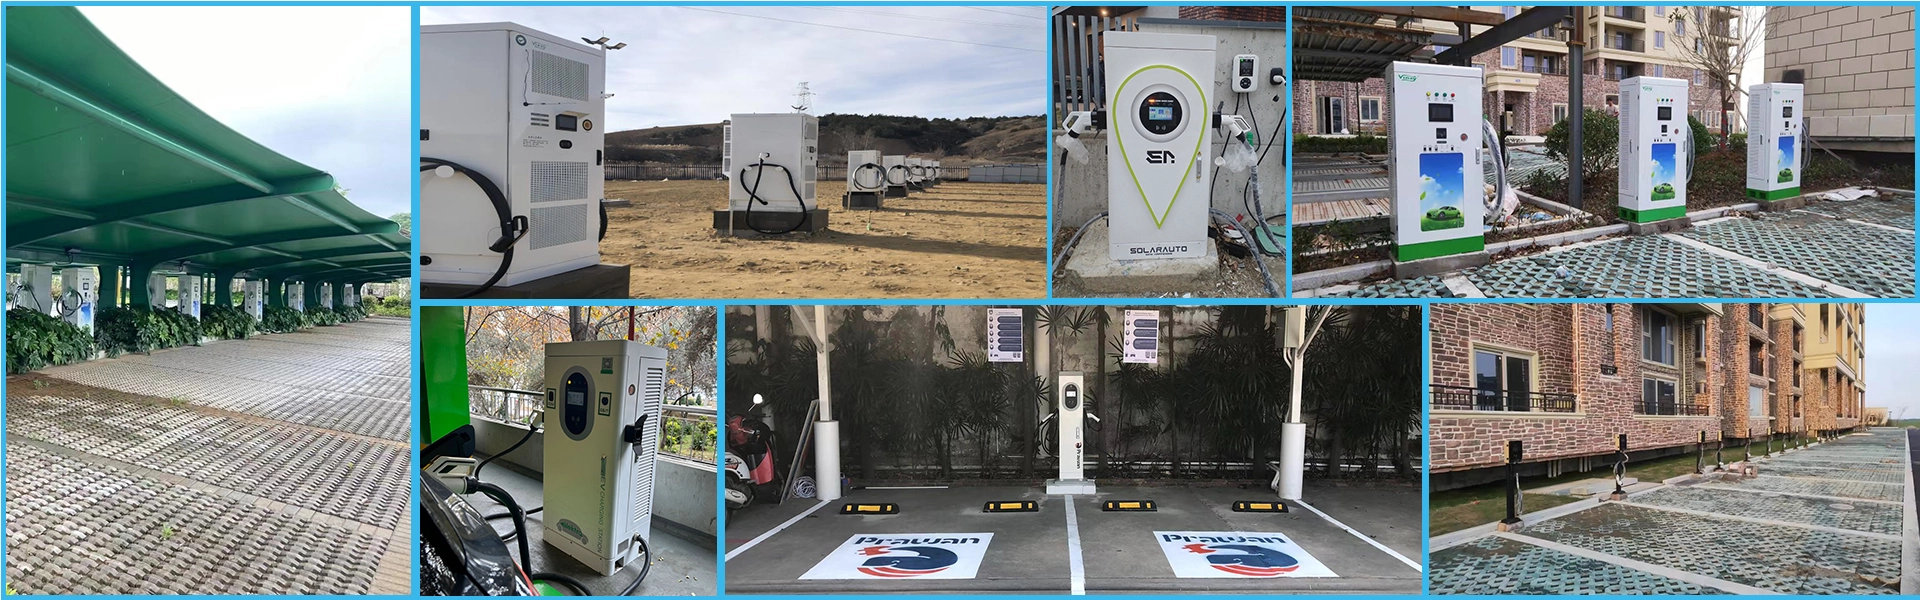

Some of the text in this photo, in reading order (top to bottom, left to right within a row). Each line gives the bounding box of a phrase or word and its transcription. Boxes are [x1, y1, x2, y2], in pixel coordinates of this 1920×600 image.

[1130, 245, 1188, 255] SOLARAUTO
[597, 490, 606, 526] CHARGING
[596, 528, 604, 554] STATION
[854, 536, 981, 546] Prawan
[1162, 533, 1287, 544] Prawan
